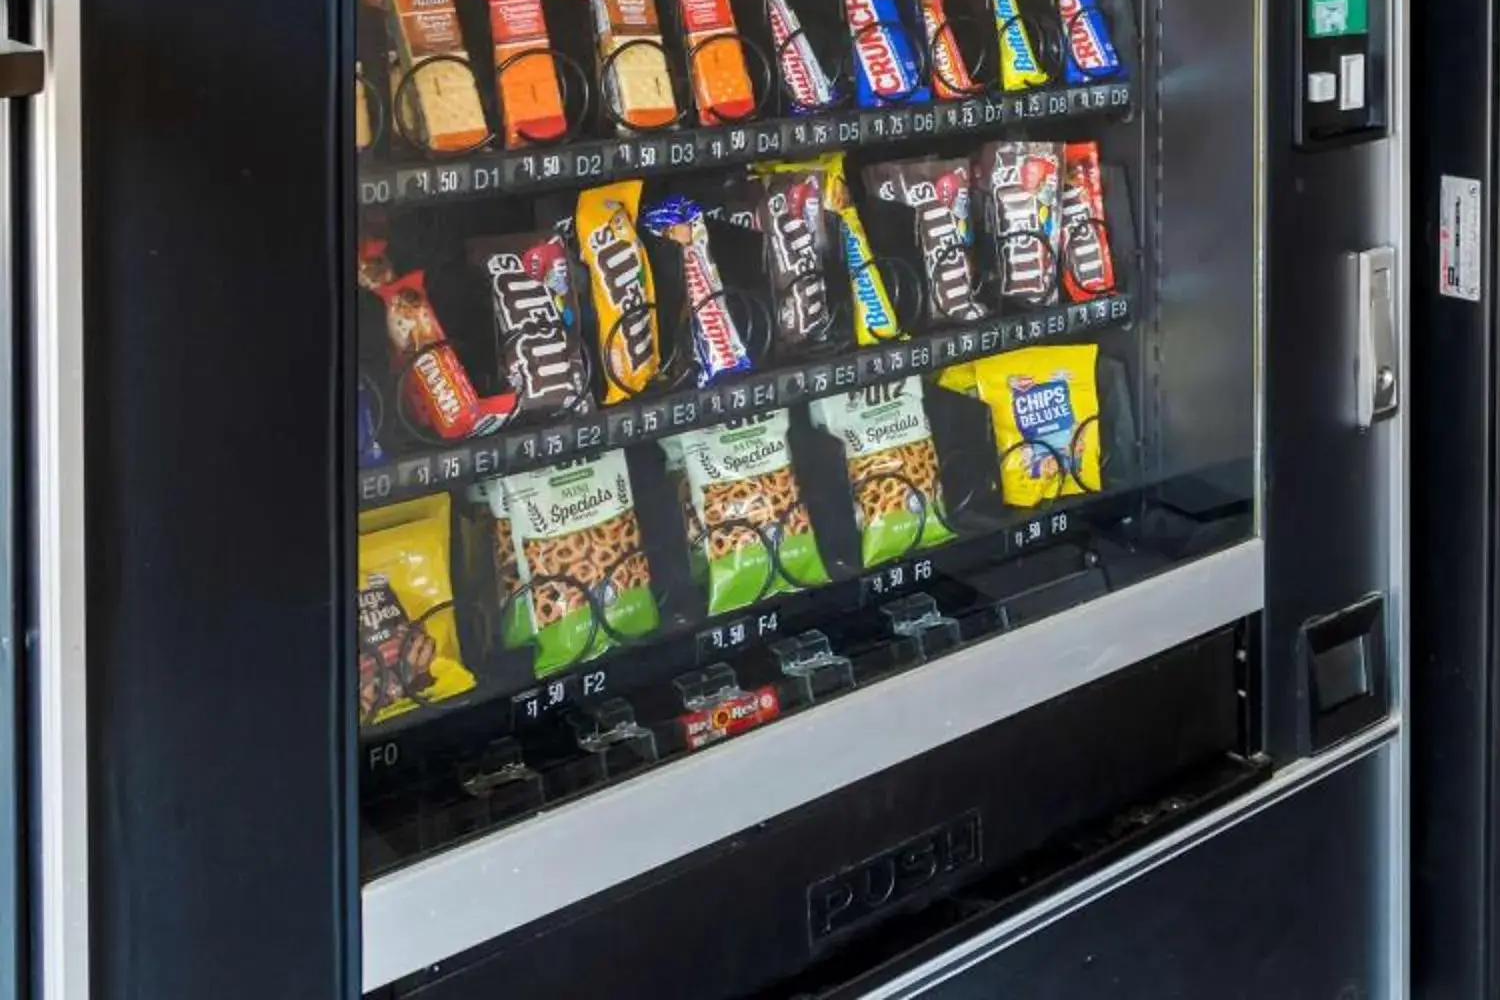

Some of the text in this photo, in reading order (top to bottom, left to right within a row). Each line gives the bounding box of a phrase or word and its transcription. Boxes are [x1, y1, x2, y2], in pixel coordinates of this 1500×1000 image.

[1049, 97, 1067, 114] D8
[1111, 89, 1128, 105] D9
[914, 113, 934, 131] D6
[985, 103, 1003, 123] D7
[758, 133, 779, 152] D4
[839, 123, 860, 142] D5
[577, 156, 601, 174] D2
[671, 145, 695, 164] D3
[361, 180, 389, 202] D0
[474, 171, 499, 190] D1
[1111, 301, 1127, 318] E9
[1047, 316, 1065, 334] E8
[981, 331, 999, 352] E7
[911, 347, 929, 368] E6
[835, 366, 855, 385] E5
[754, 384, 775, 406] E4
[1015, 385, 1065, 415] CHIPS
[673, 403, 695, 425] E3
[1020, 402, 1070, 430] DELUXE
[577, 427, 601, 447] E2
[866, 414, 919, 444] Specials
[475, 452, 499, 473] E1
[723, 440, 785, 473] Specials
[362, 474, 391, 499] E0
[551, 487, 613, 527] Specials
[1051, 512, 1067, 535] F8
[915, 561, 932, 581] F6
[758, 613, 778, 635] F4
[583, 671, 605, 696] F2
[369, 742, 398, 768] F0
